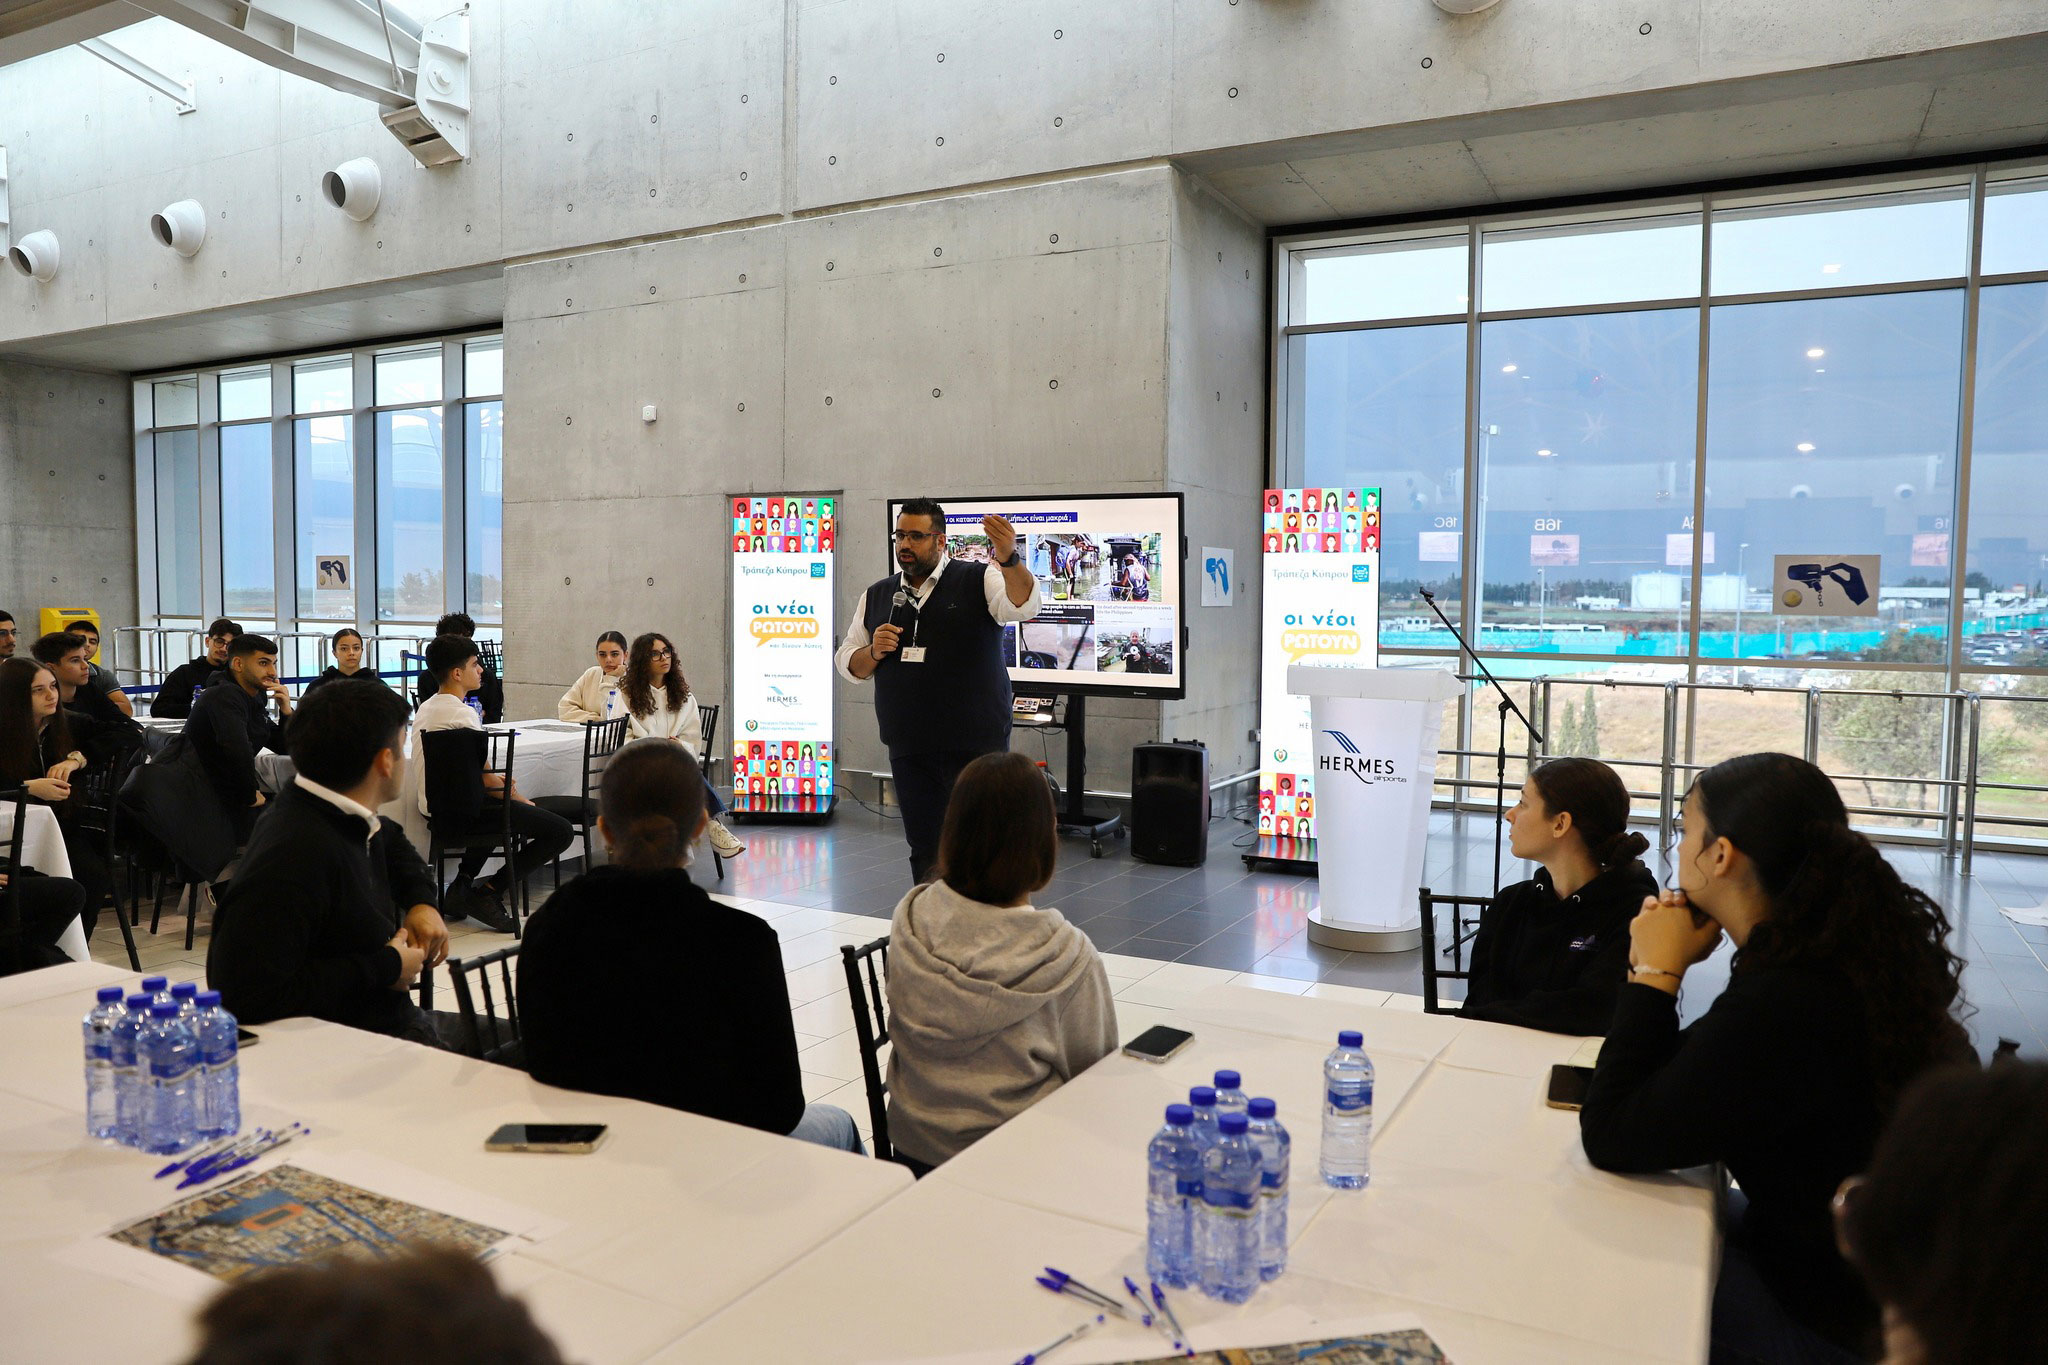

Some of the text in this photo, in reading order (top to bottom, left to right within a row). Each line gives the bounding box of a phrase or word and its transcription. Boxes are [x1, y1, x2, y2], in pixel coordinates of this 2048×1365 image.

[741, 566, 808, 576] Τράπεζα Κύπρου
[1272, 569, 1349, 581] Τράπεζα Κύπρου
[776, 600, 815, 614] νέοι
[1312, 609, 1356, 626] νέοι
[753, 621, 816, 634] ΡΩΤΟΥΝ
[767, 696, 798, 707] HERMES
[1320, 755, 1394, 784] HERMES
